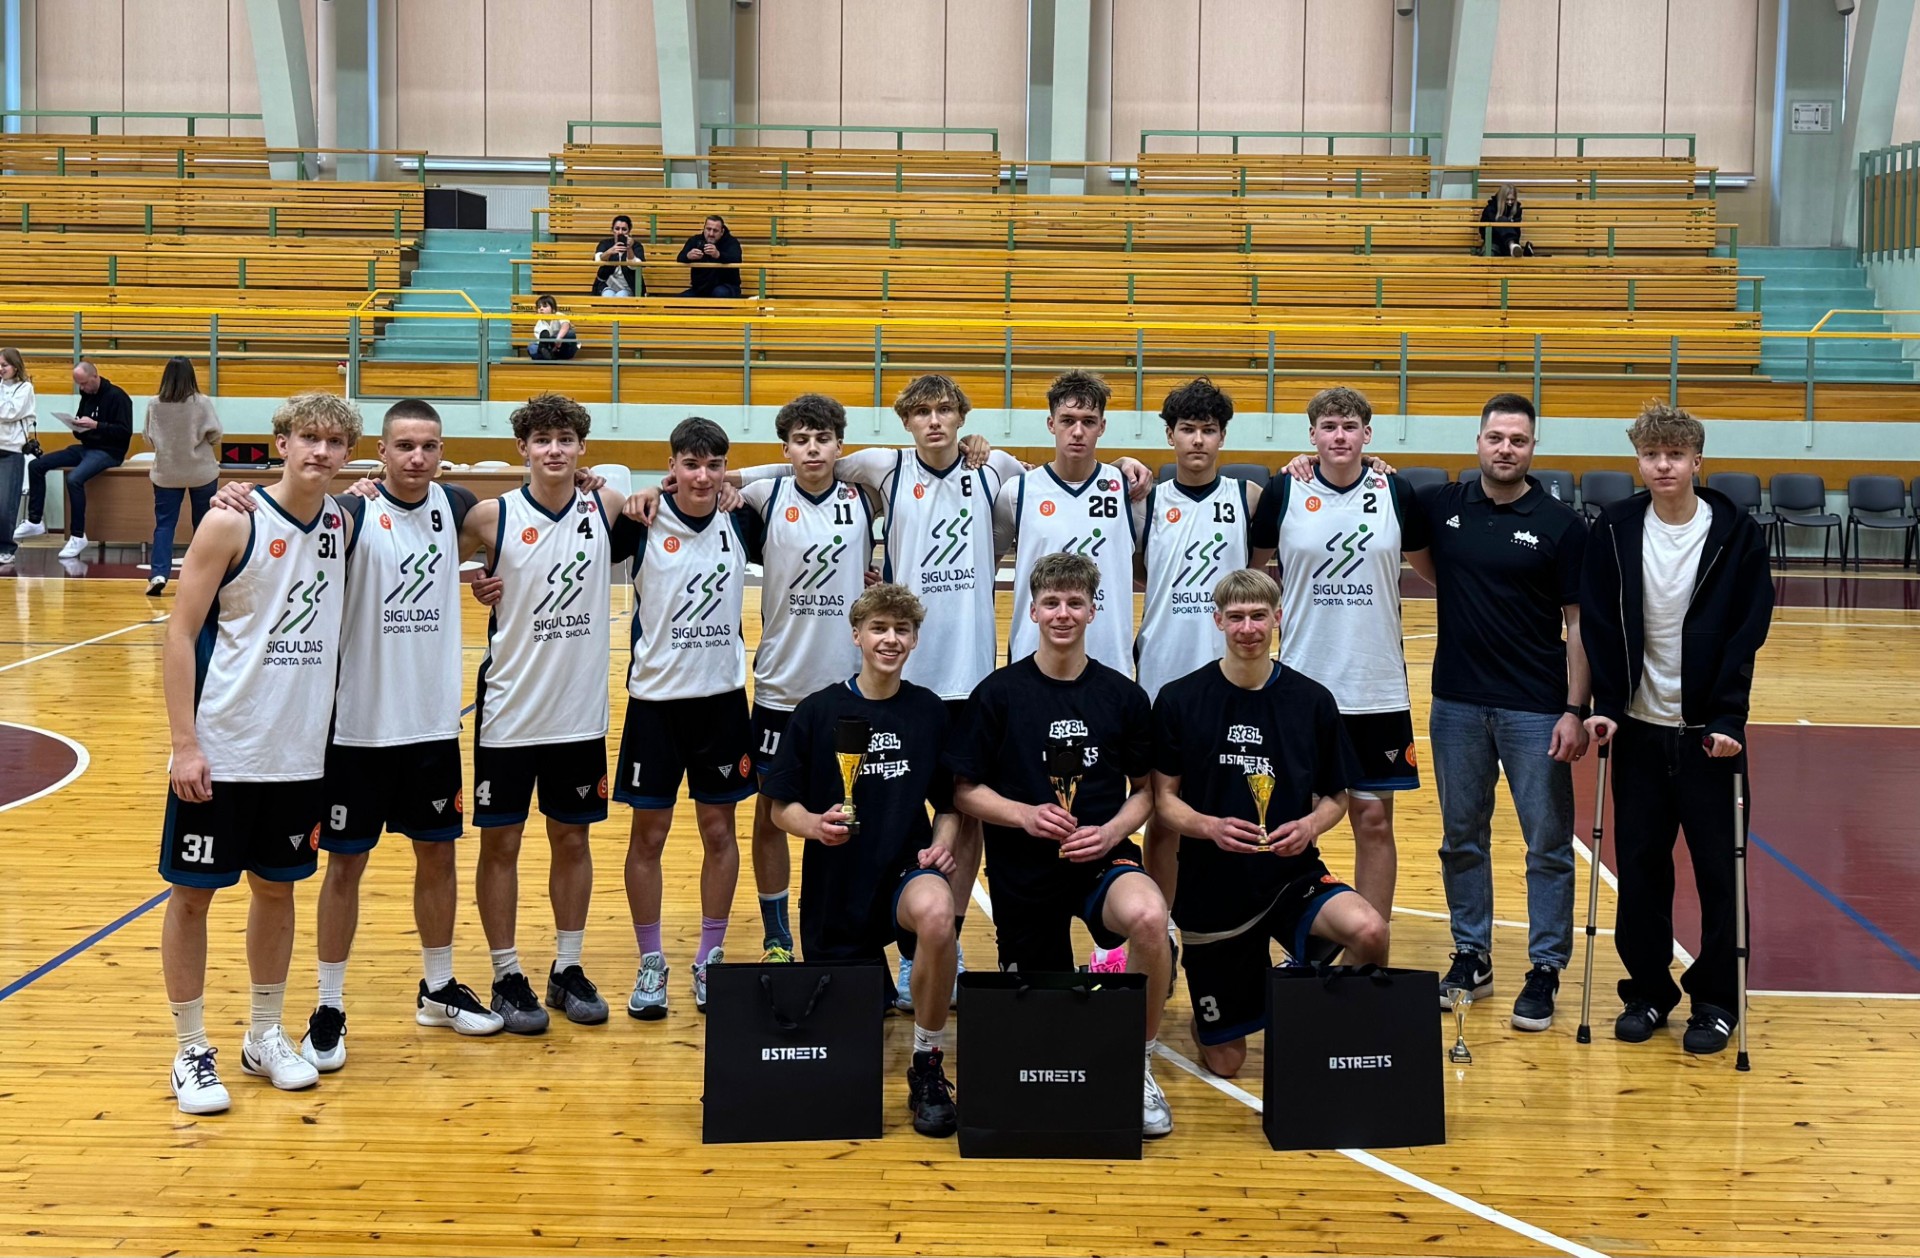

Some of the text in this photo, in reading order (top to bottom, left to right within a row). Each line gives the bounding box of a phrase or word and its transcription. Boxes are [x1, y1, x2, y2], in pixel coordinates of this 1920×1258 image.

[960, 475, 972, 497] 8
[1088, 495, 1118, 518] 26
[1213, 501, 1235, 523] 13
[1363, 492, 1377, 513] 2
[430, 509, 443, 532] 9
[833, 503, 853, 525] 11
[577, 517, 593, 540] 4
[318, 533, 337, 559] 31
[719, 530, 730, 552] 1
[921, 568, 975, 584] SIGULDAS
[922, 585, 952, 594] SPORTA
[1172, 592, 1215, 604] SIGULDA
[1313, 584, 1373, 595] SIGULDAS
[790, 594, 844, 606] SIGULDAS
[1313, 598, 1373, 606] SPORTA SHOLA
[384, 608, 440, 623] SIGULDAS
[790, 608, 844, 617] SPORTA SHOLA
[1172, 606, 1199, 614] SPORTA
[383, 624, 439, 634] SPORTA SHOLA
[533, 613, 591, 632] SIGULDAS
[672, 624, 731, 639] SIGULDAS
[533, 628, 591, 642] SPORTA SHOLA
[672, 639, 731, 650] SPORTA SHOLA
[266, 640, 323, 653] SIGULDAS
[262, 657, 322, 666] SPORTA SHOLA
[1049, 719, 1088, 739] EYBL
[1227, 724, 1263, 745] EYBL
[759, 728, 781, 755] 11
[632, 762, 641, 787] 1
[861, 760, 909, 775] STREETS
[475, 780, 491, 806] 4
[330, 804, 347, 831] 9
[181, 833, 214, 864] 31
[1199, 995, 1220, 1022] 3
